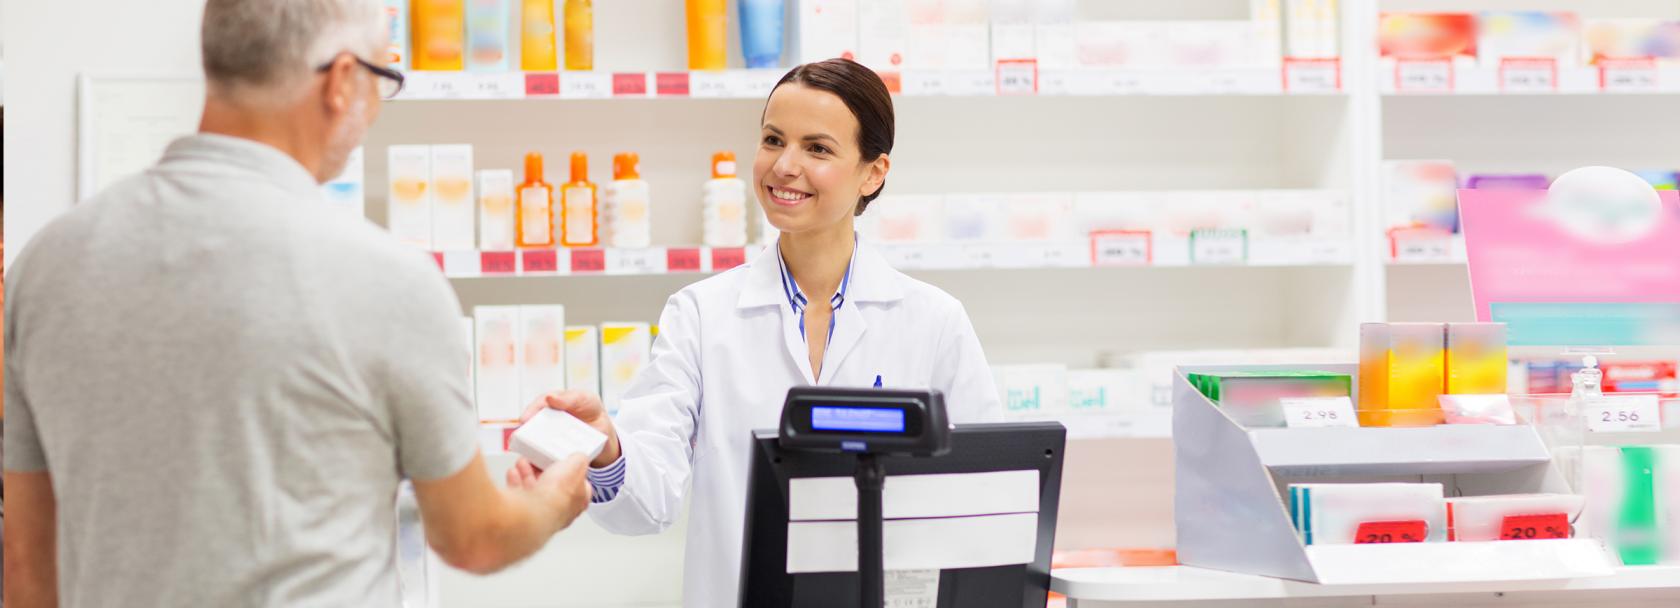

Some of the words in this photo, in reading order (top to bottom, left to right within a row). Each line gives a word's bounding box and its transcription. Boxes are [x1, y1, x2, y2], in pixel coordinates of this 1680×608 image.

[1303, 410, 1338, 420] 2.98
[1601, 410, 1640, 422] 2.56
[1504, 527, 1537, 539] -20
[1545, 526, 1564, 538] %
